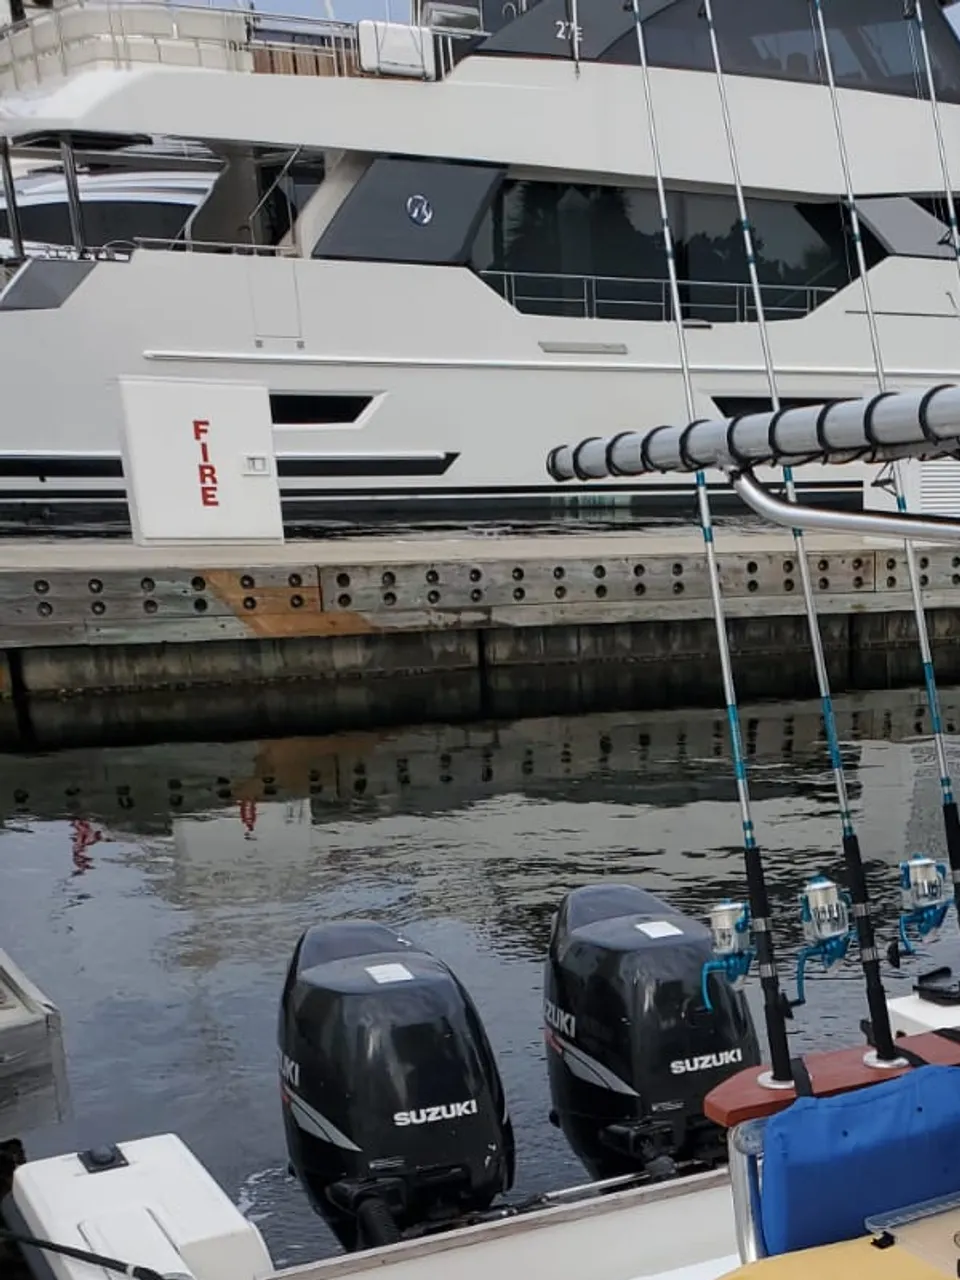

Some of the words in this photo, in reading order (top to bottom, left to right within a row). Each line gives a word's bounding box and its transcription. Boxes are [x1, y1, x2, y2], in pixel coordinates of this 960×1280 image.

[192, 419, 219, 507] FIRE
[670, 1048, 743, 1075] SUZUKI
[393, 1099, 478, 1127] SUZUKI
